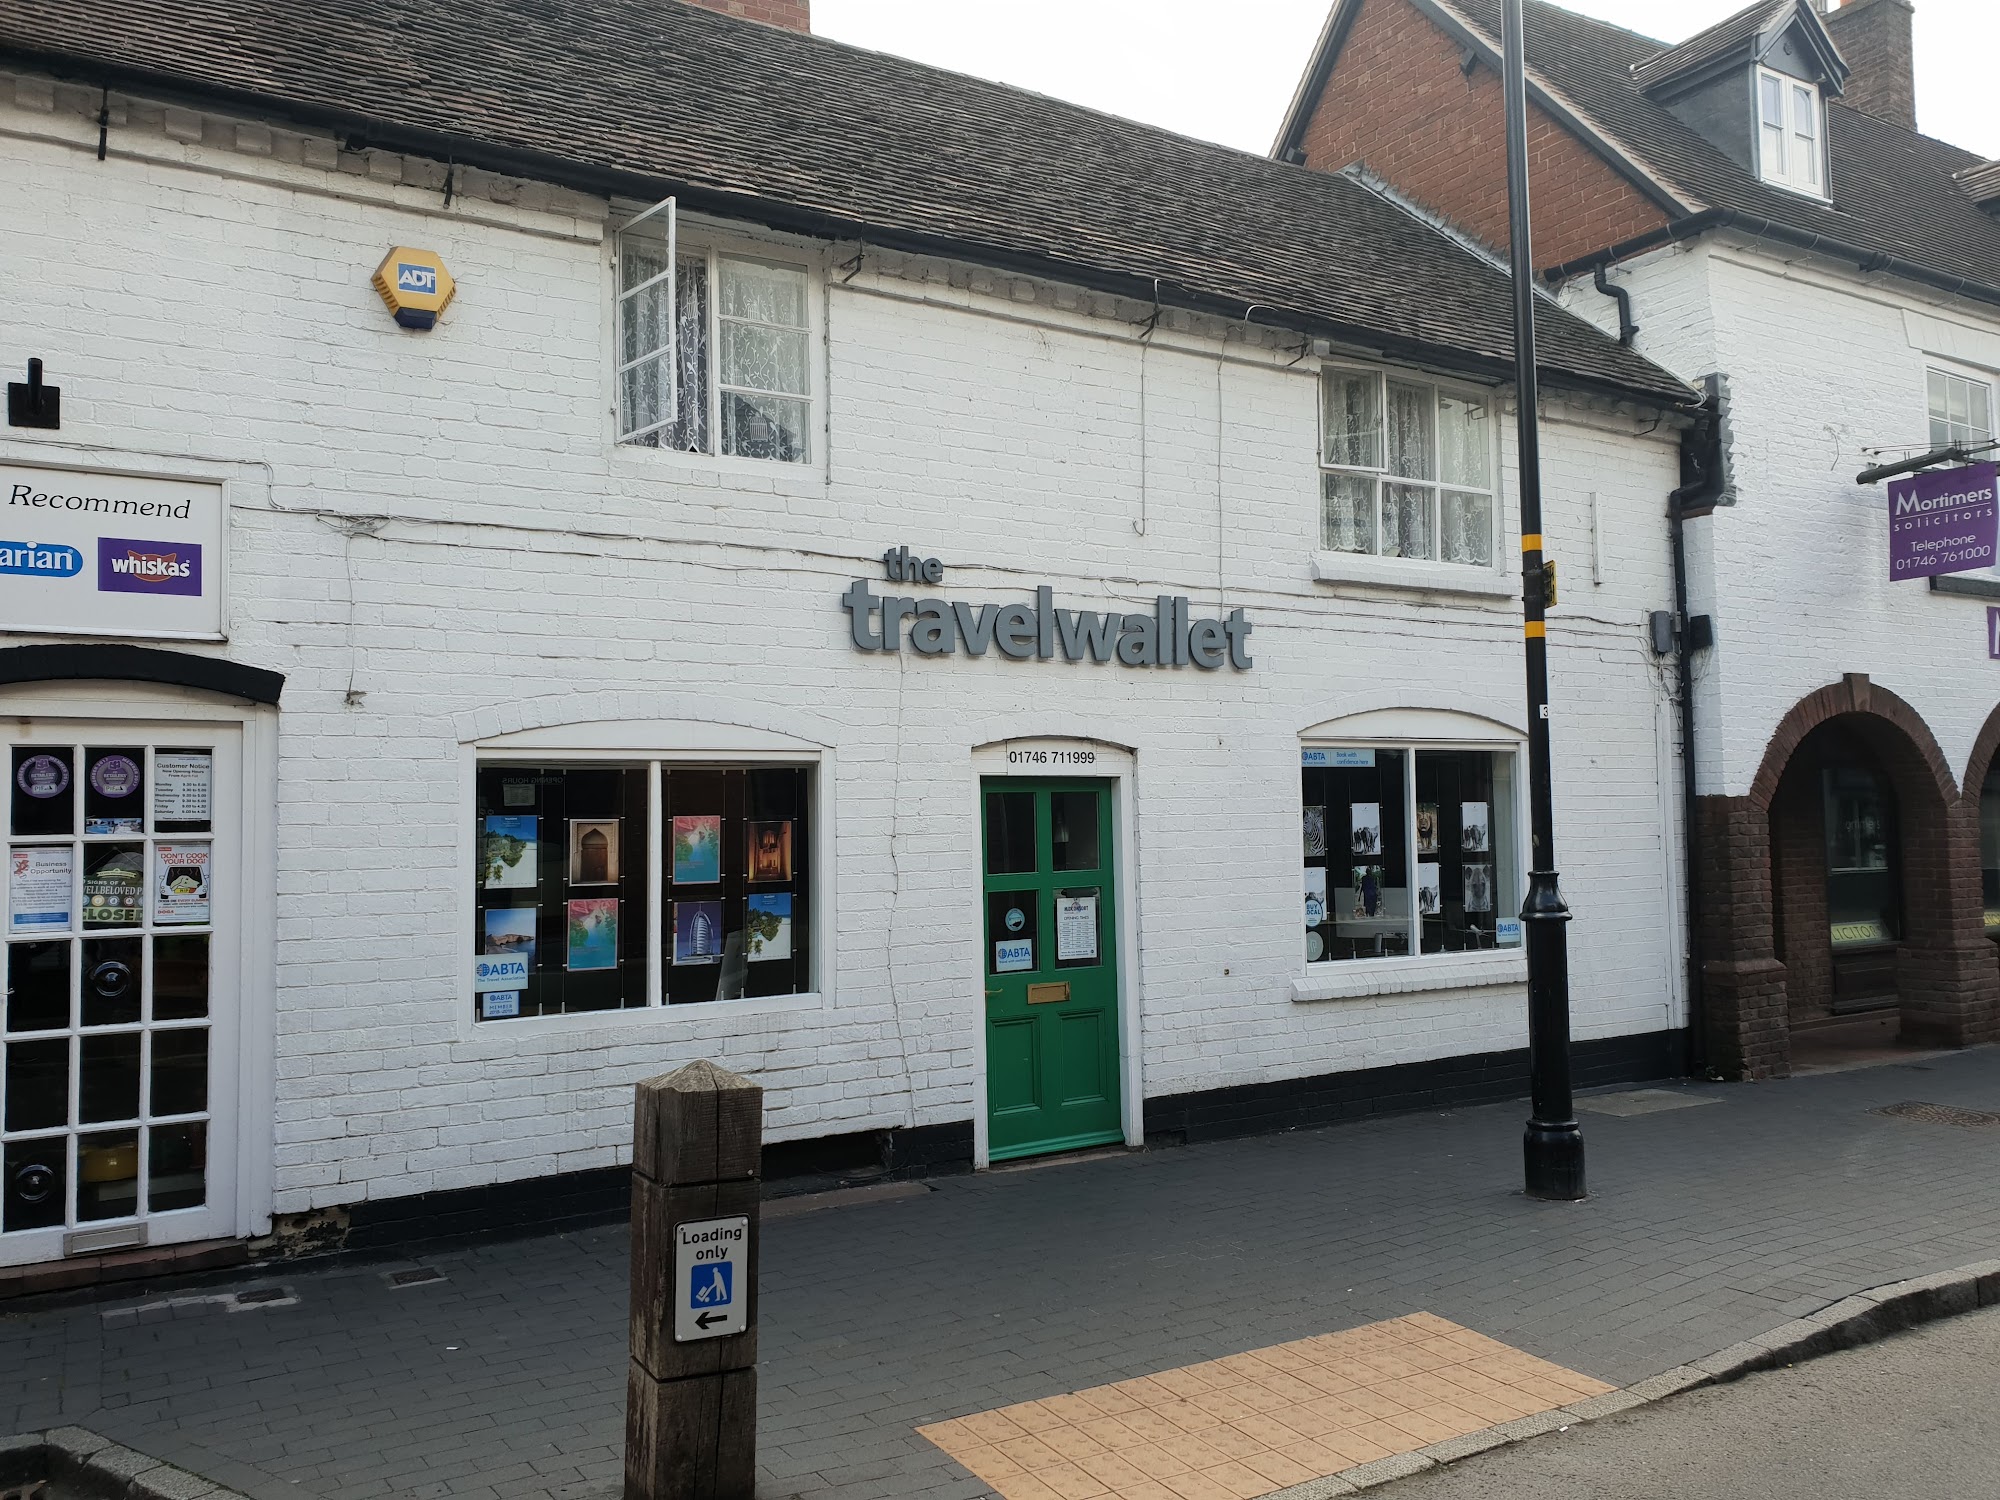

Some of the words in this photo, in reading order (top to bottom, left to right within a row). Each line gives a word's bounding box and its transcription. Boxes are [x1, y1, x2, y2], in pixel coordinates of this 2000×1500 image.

[398, 269, 434, 288] ADT
[9, 484, 191, 519] Recommend
[1895, 488, 1992, 515] Mortimers
[1894, 508, 1992, 531] solicitors
[1911, 534, 1976, 552] Telephone
[111, 556, 190, 577] whiskas
[884, 546, 943, 583] the
[1896, 555, 1937, 570] 01746
[1942, 545, 1991, 563] 761000
[843, 580, 1252, 669] travelwallet
[1009, 751, 1047, 764] 01746
[1051, 751, 1095, 764] 711999
[1308, 752, 1326, 760] ABTA
[1503, 924, 1519, 932] ABTA
[1007, 947, 1030, 958] ABTA
[490, 962, 526, 976] ABTA
[682, 1228, 742, 1245] Loading
[696, 1245, 728, 1260] only
